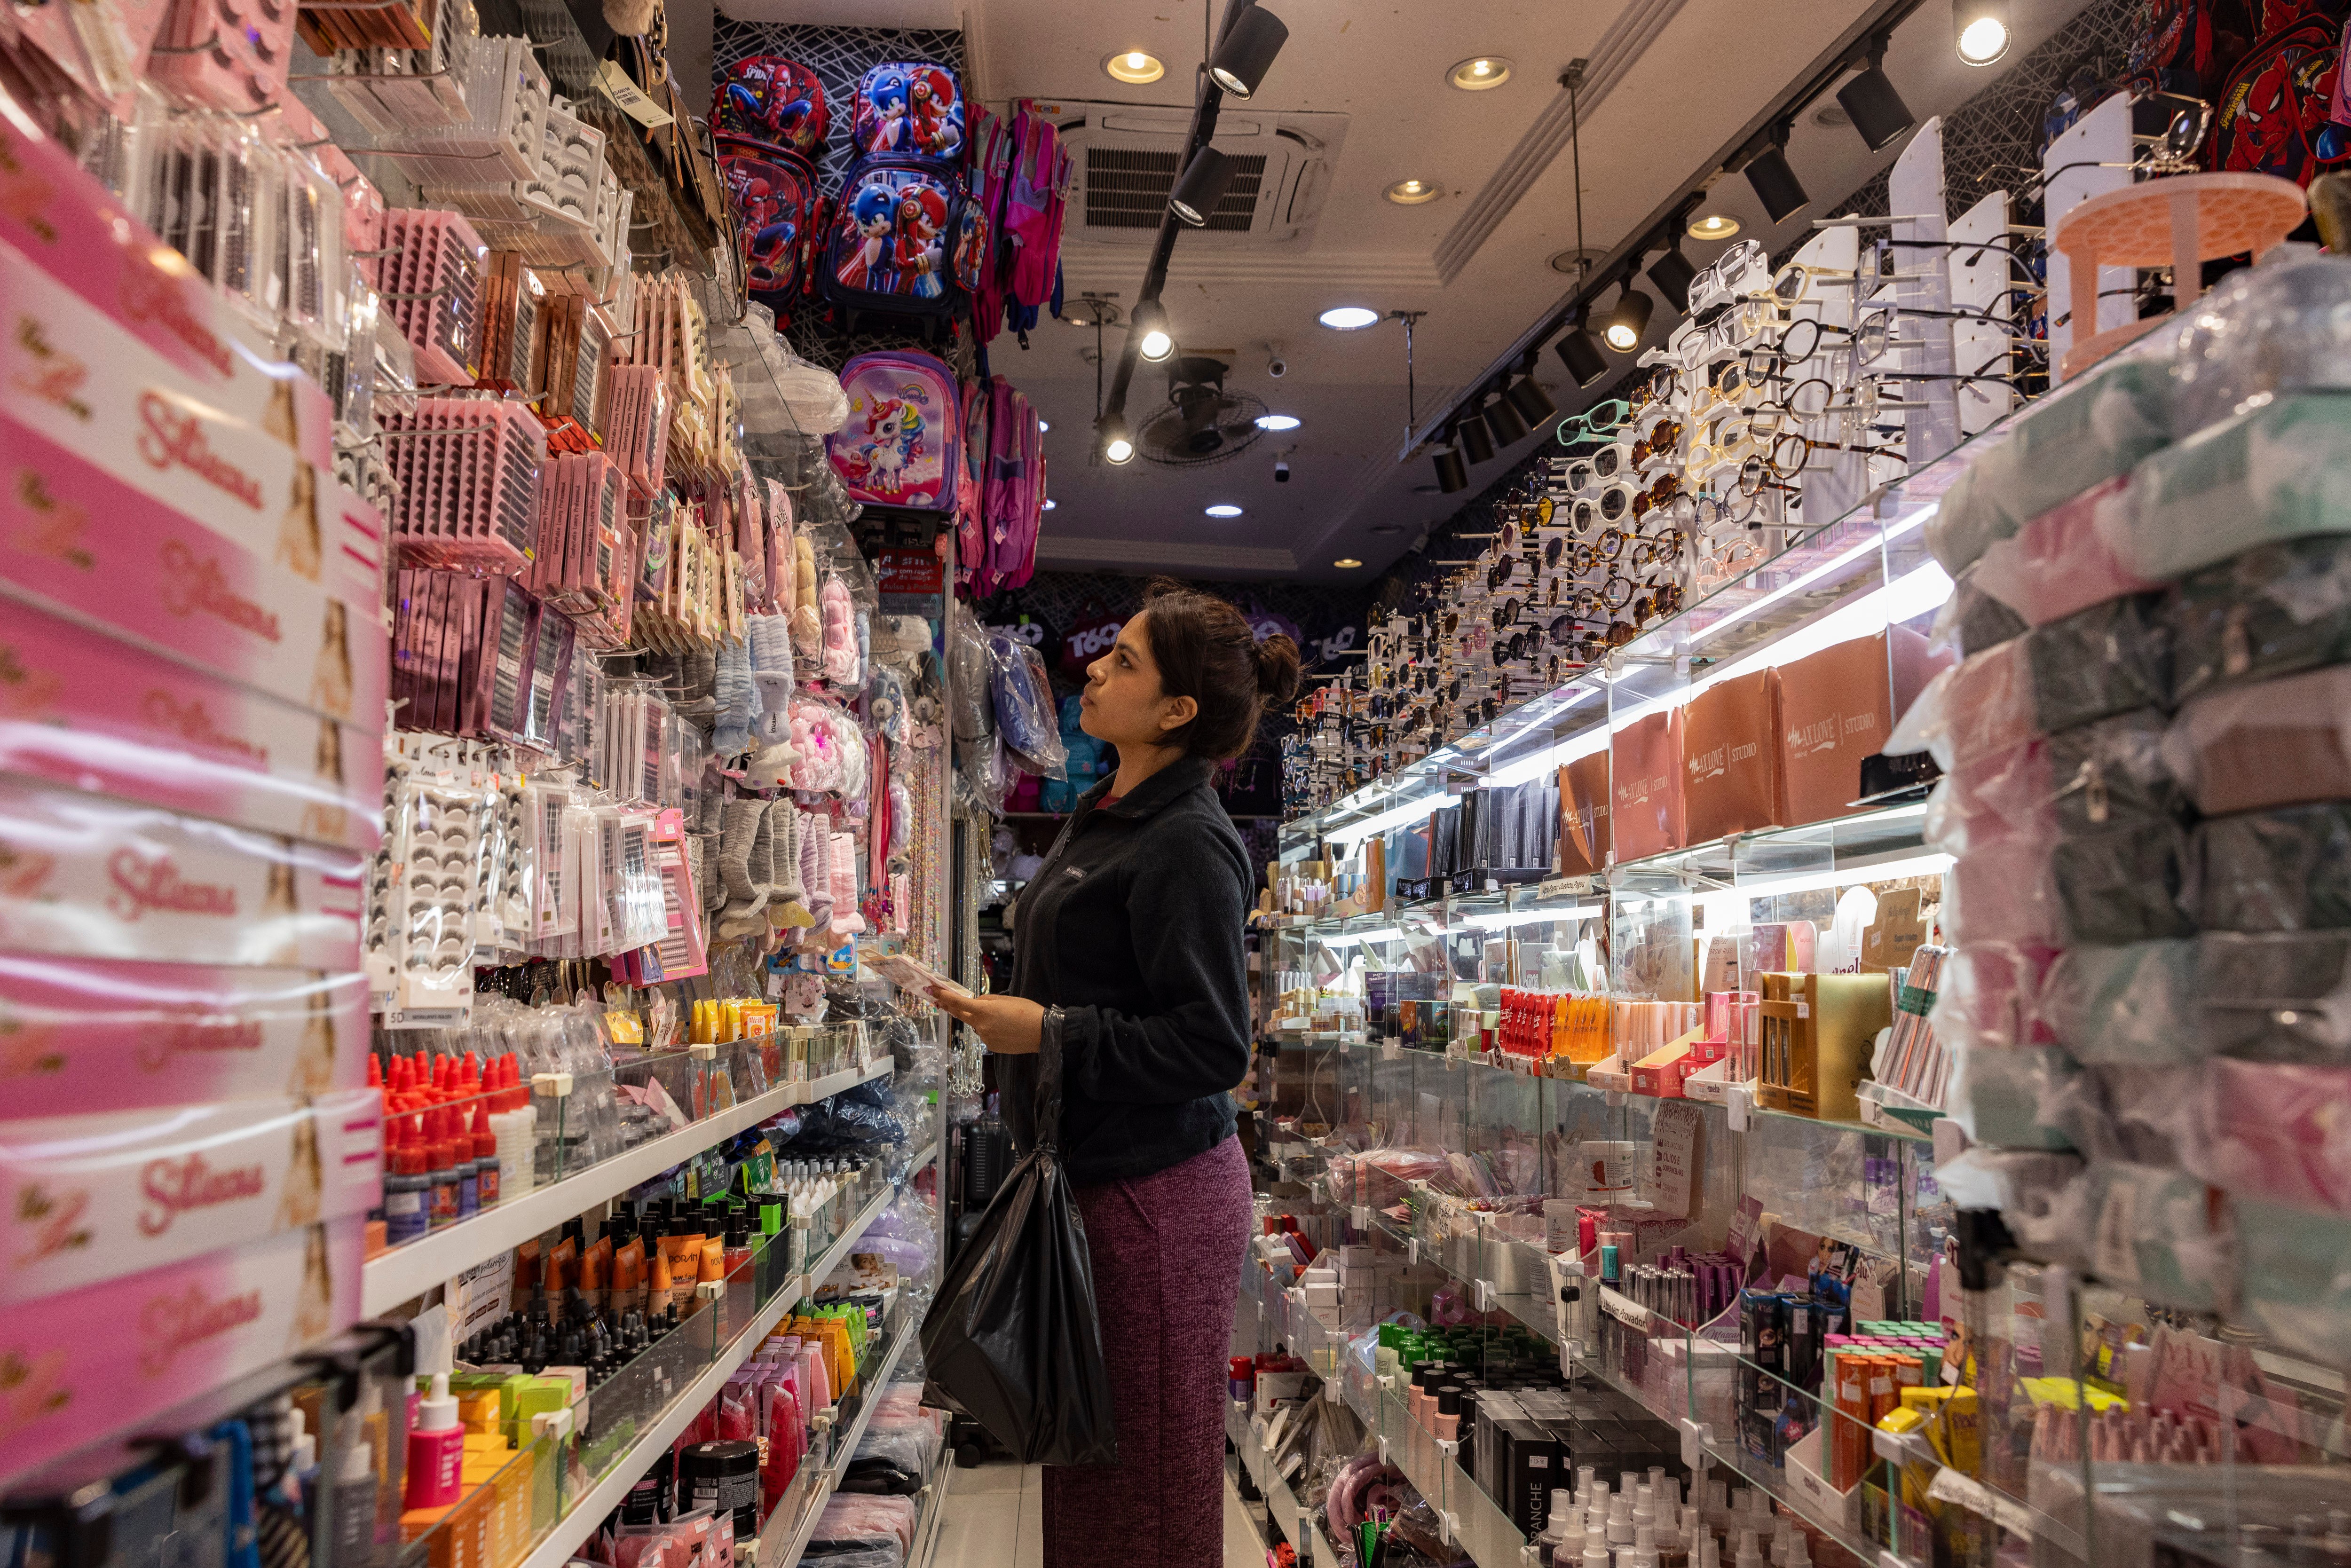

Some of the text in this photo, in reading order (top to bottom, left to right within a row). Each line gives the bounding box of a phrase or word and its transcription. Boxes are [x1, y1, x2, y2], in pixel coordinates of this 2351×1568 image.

[1812, 717, 1834, 741] LOVE
[1845, 712, 1875, 735] STUDIO
[1708, 748, 1724, 768] LOVE
[1732, 742, 1757, 762] STUDIO
[1635, 778, 1648, 797] LOVE
[1654, 775, 1667, 791] STUDIO
[1594, 805, 1608, 818] STUDIO
[1069, 868, 1082, 878] Columbia
[390, 1012, 404, 1023] 5D
[1663, 1151, 1677, 1165] CÍLIOS
[1663, 1164, 1683, 1177] SOBRANCELHAS
[1619, 1308, 1646, 1328] Provador
